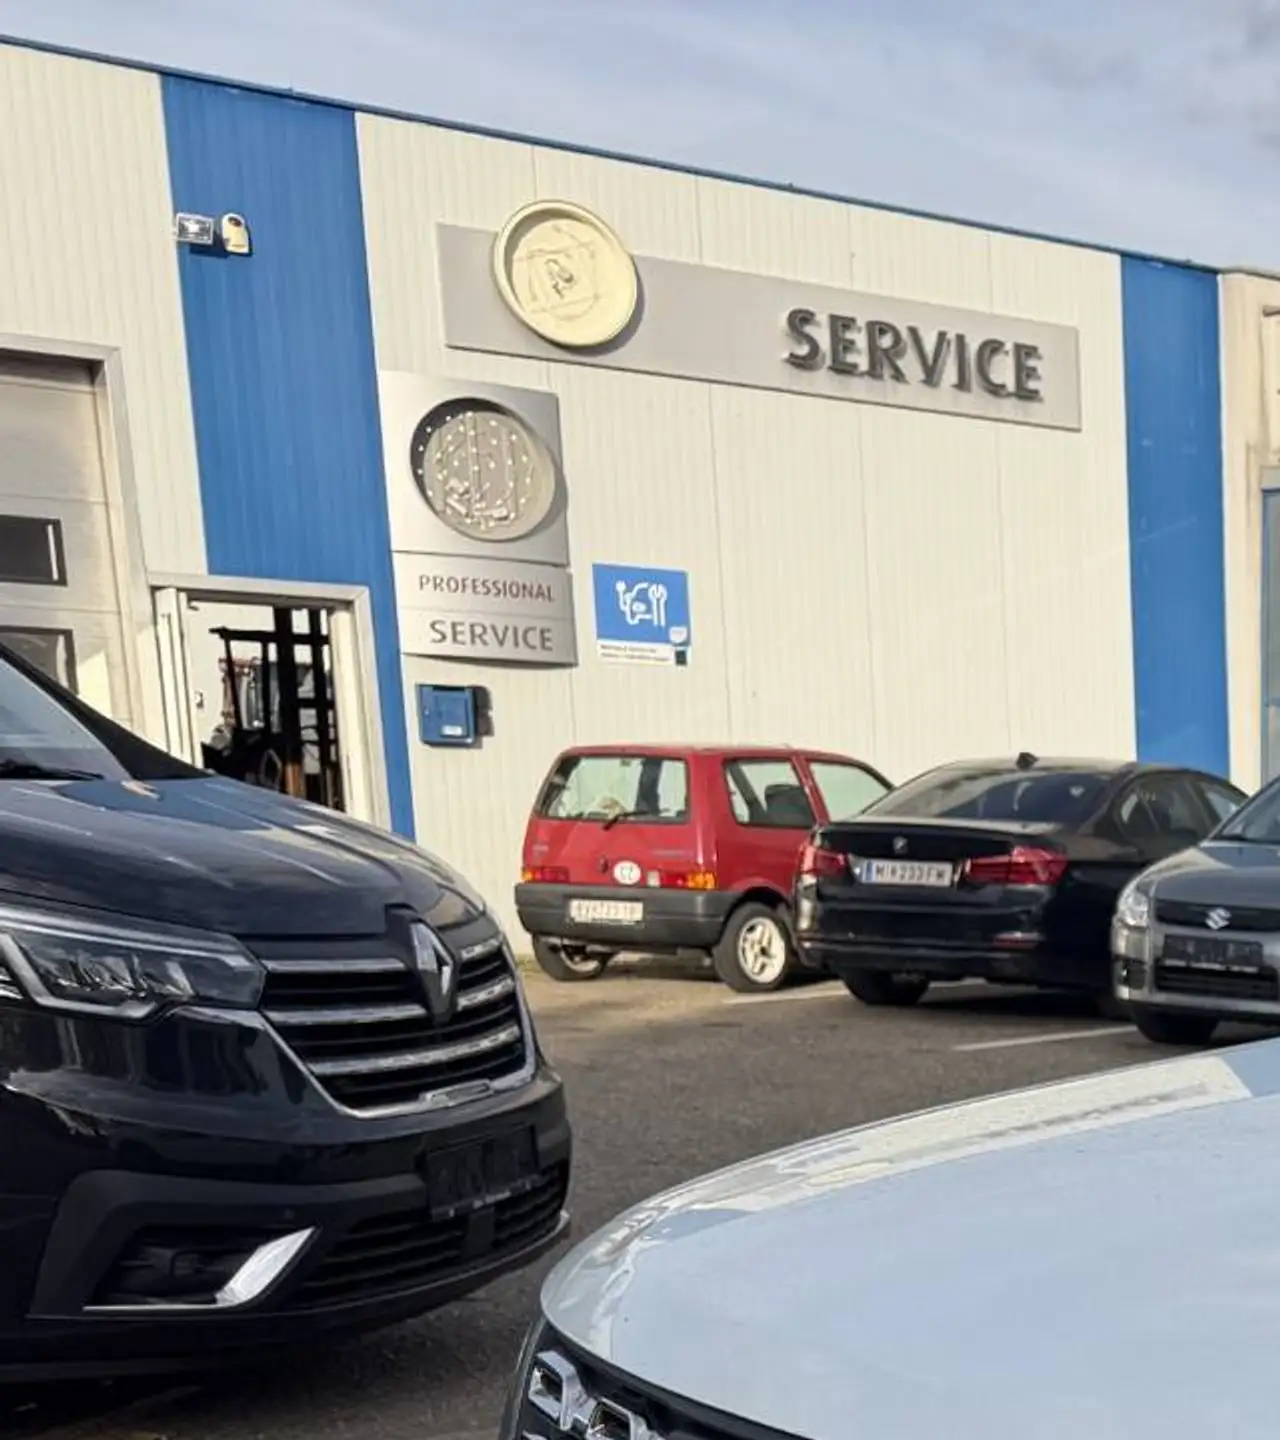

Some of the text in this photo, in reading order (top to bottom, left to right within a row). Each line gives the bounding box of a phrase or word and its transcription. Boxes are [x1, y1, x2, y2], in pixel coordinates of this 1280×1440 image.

[785, 307, 1041, 402] SERVICE
[418, 573, 556, 603] PROFESSIONAL
[429, 619, 554, 652] SERVICE
